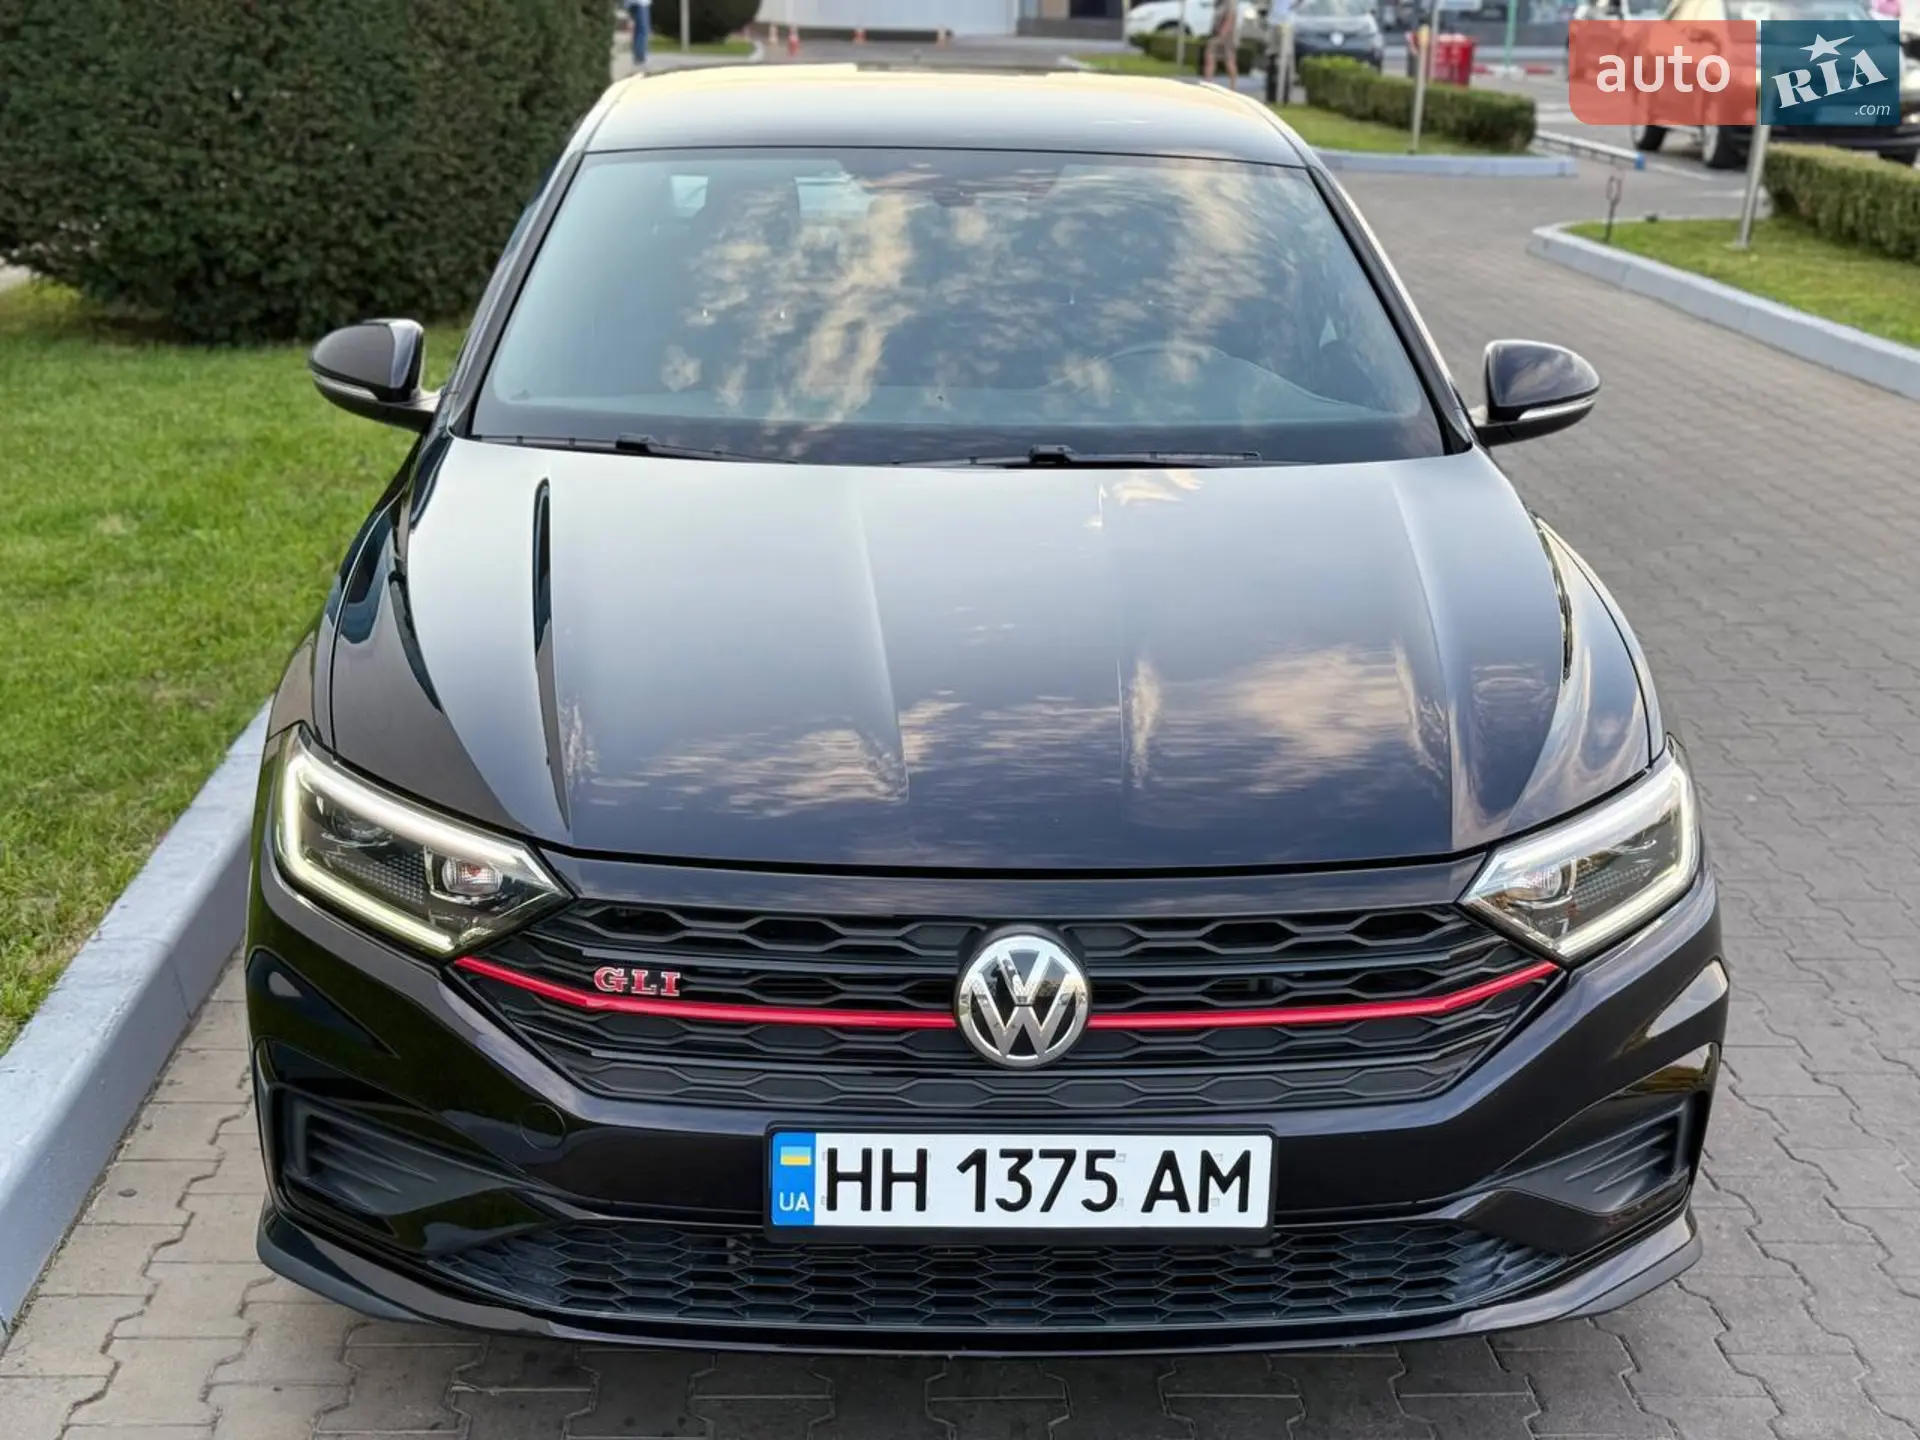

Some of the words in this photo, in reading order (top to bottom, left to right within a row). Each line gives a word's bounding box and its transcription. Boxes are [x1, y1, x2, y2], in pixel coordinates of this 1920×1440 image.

[593, 966, 681, 997] GLI
[826, 1147, 928, 1212] HH
[956, 1148, 1119, 1213] 1375
[1140, 1149, 1252, 1213] AM
[779, 1192, 811, 1213] UA
